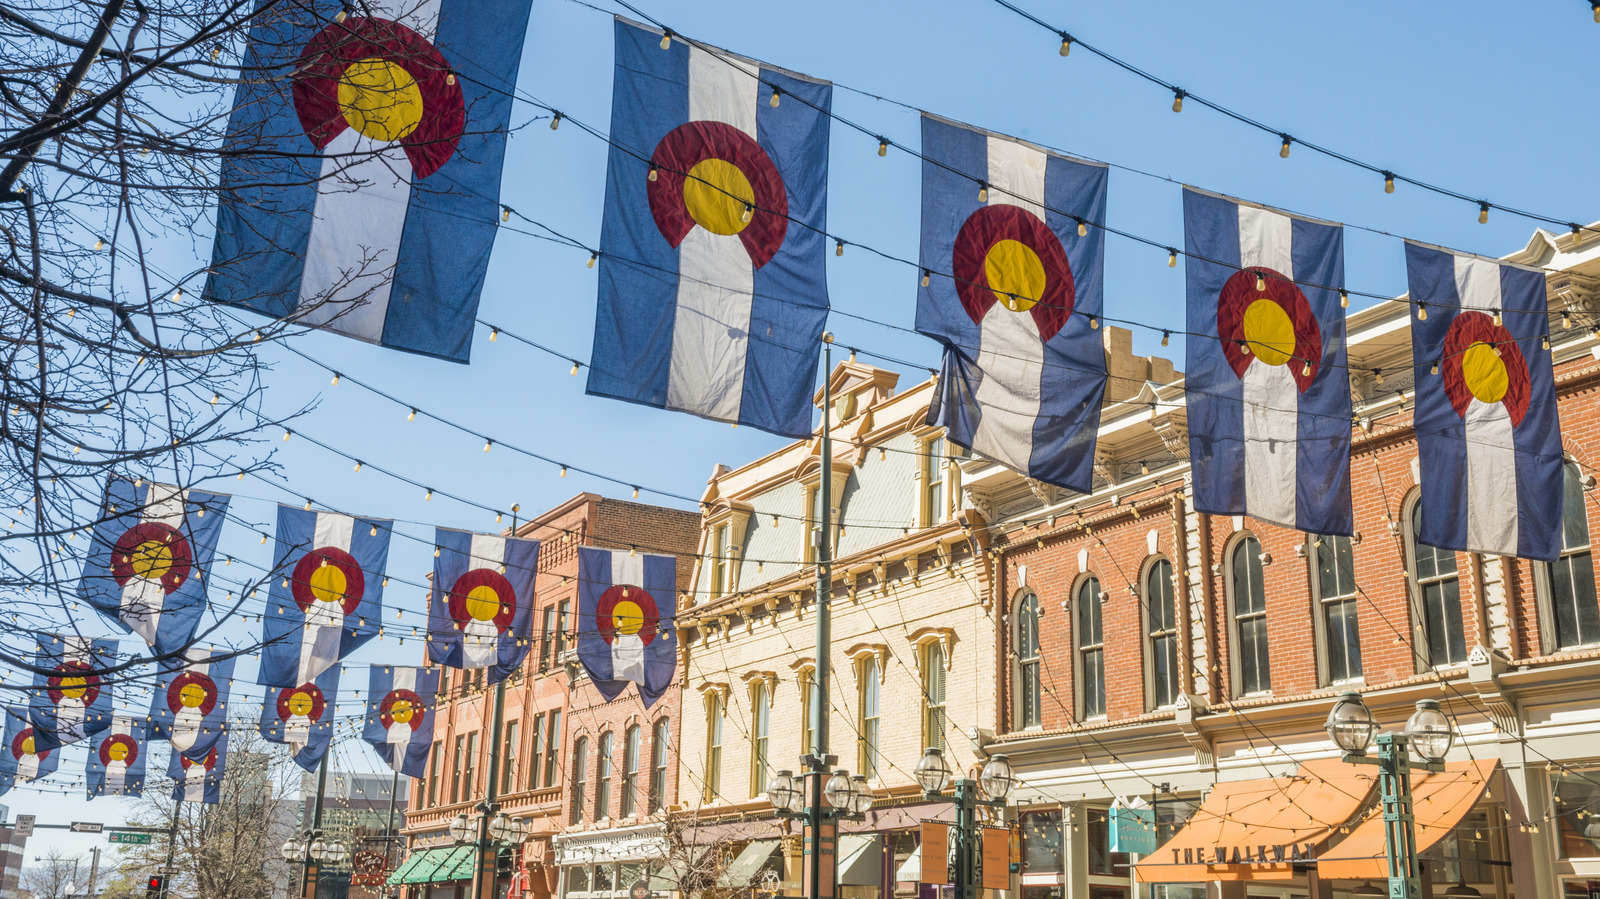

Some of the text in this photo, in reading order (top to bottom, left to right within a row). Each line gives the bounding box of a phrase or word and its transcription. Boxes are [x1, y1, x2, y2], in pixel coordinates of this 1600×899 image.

[121, 834, 138, 842] 14th
[1120, 835, 1154, 843] BOUTIQUE
[1172, 843, 1315, 864] THE WALKWAY
